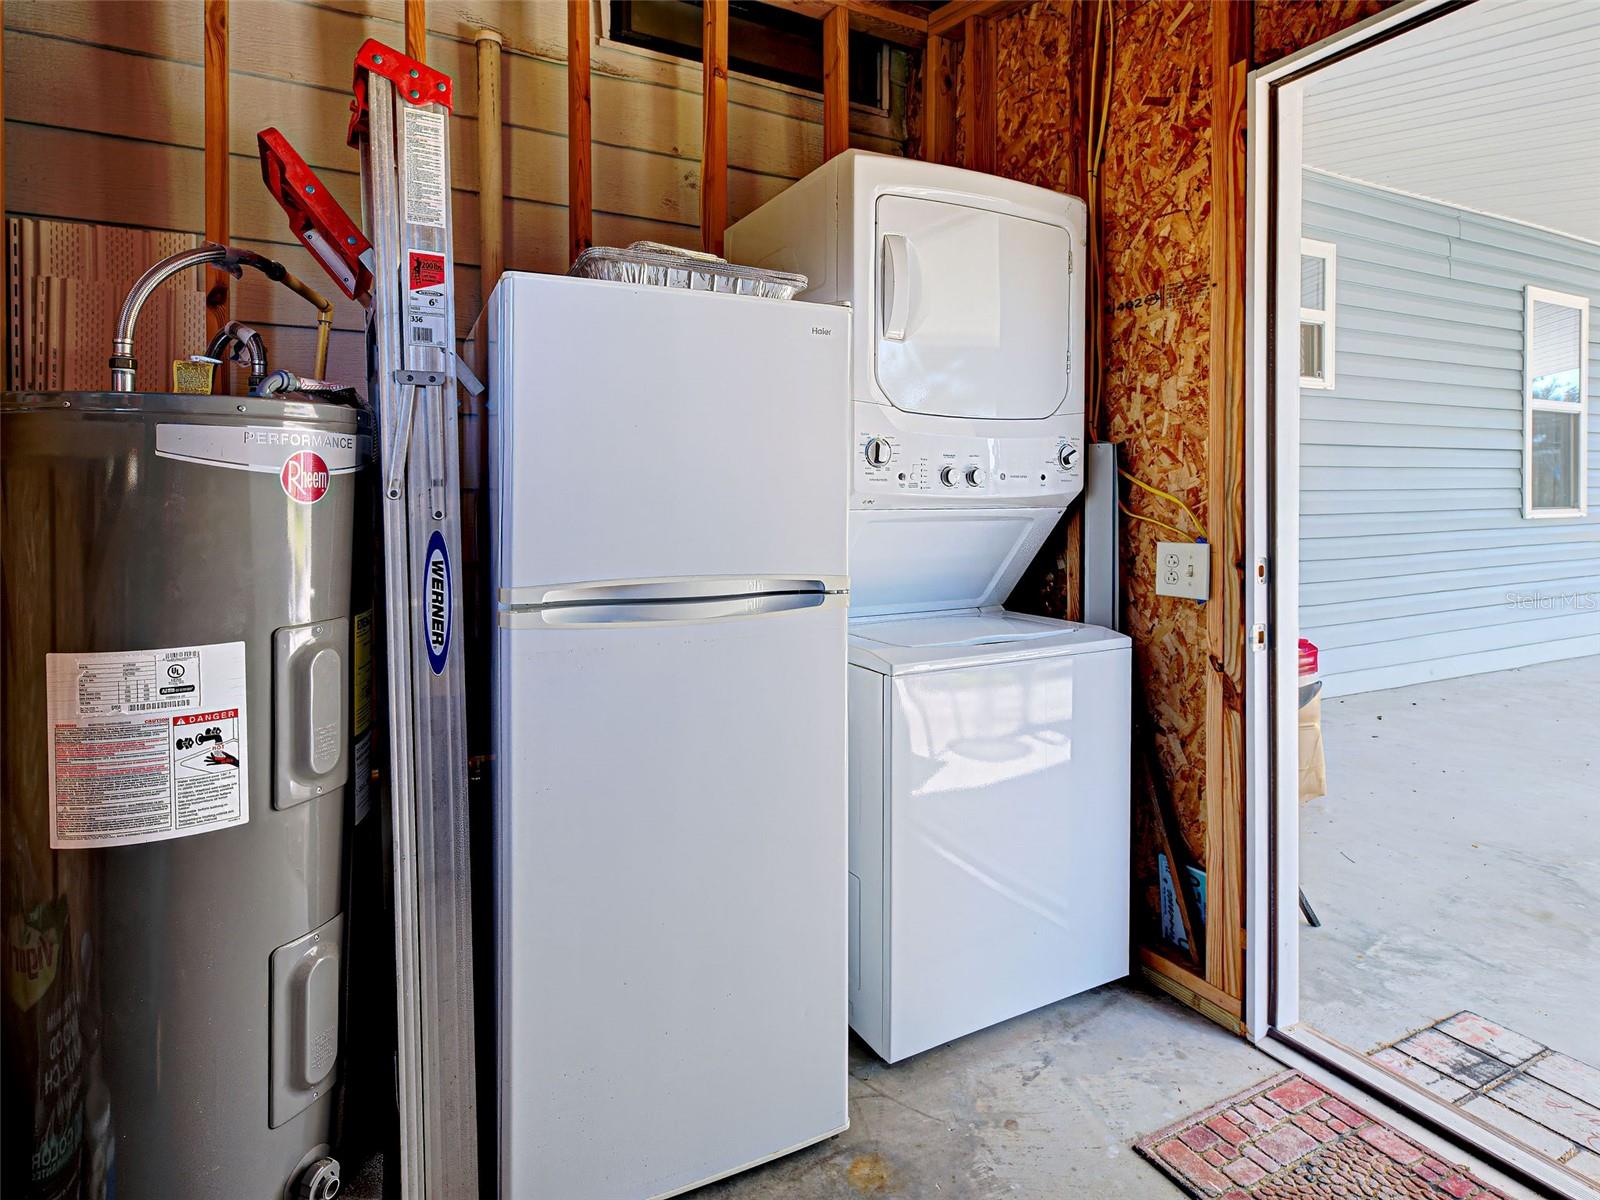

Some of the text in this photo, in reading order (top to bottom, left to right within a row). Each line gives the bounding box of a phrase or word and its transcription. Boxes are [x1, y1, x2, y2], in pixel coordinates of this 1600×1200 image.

[811, 327, 831, 336] Haier
[243, 431, 353, 449] PERFORMANCE
[288, 451, 327, 495] Rheem
[431, 560, 444, 646] WERNER
[189, 710, 235, 723] DANGER
